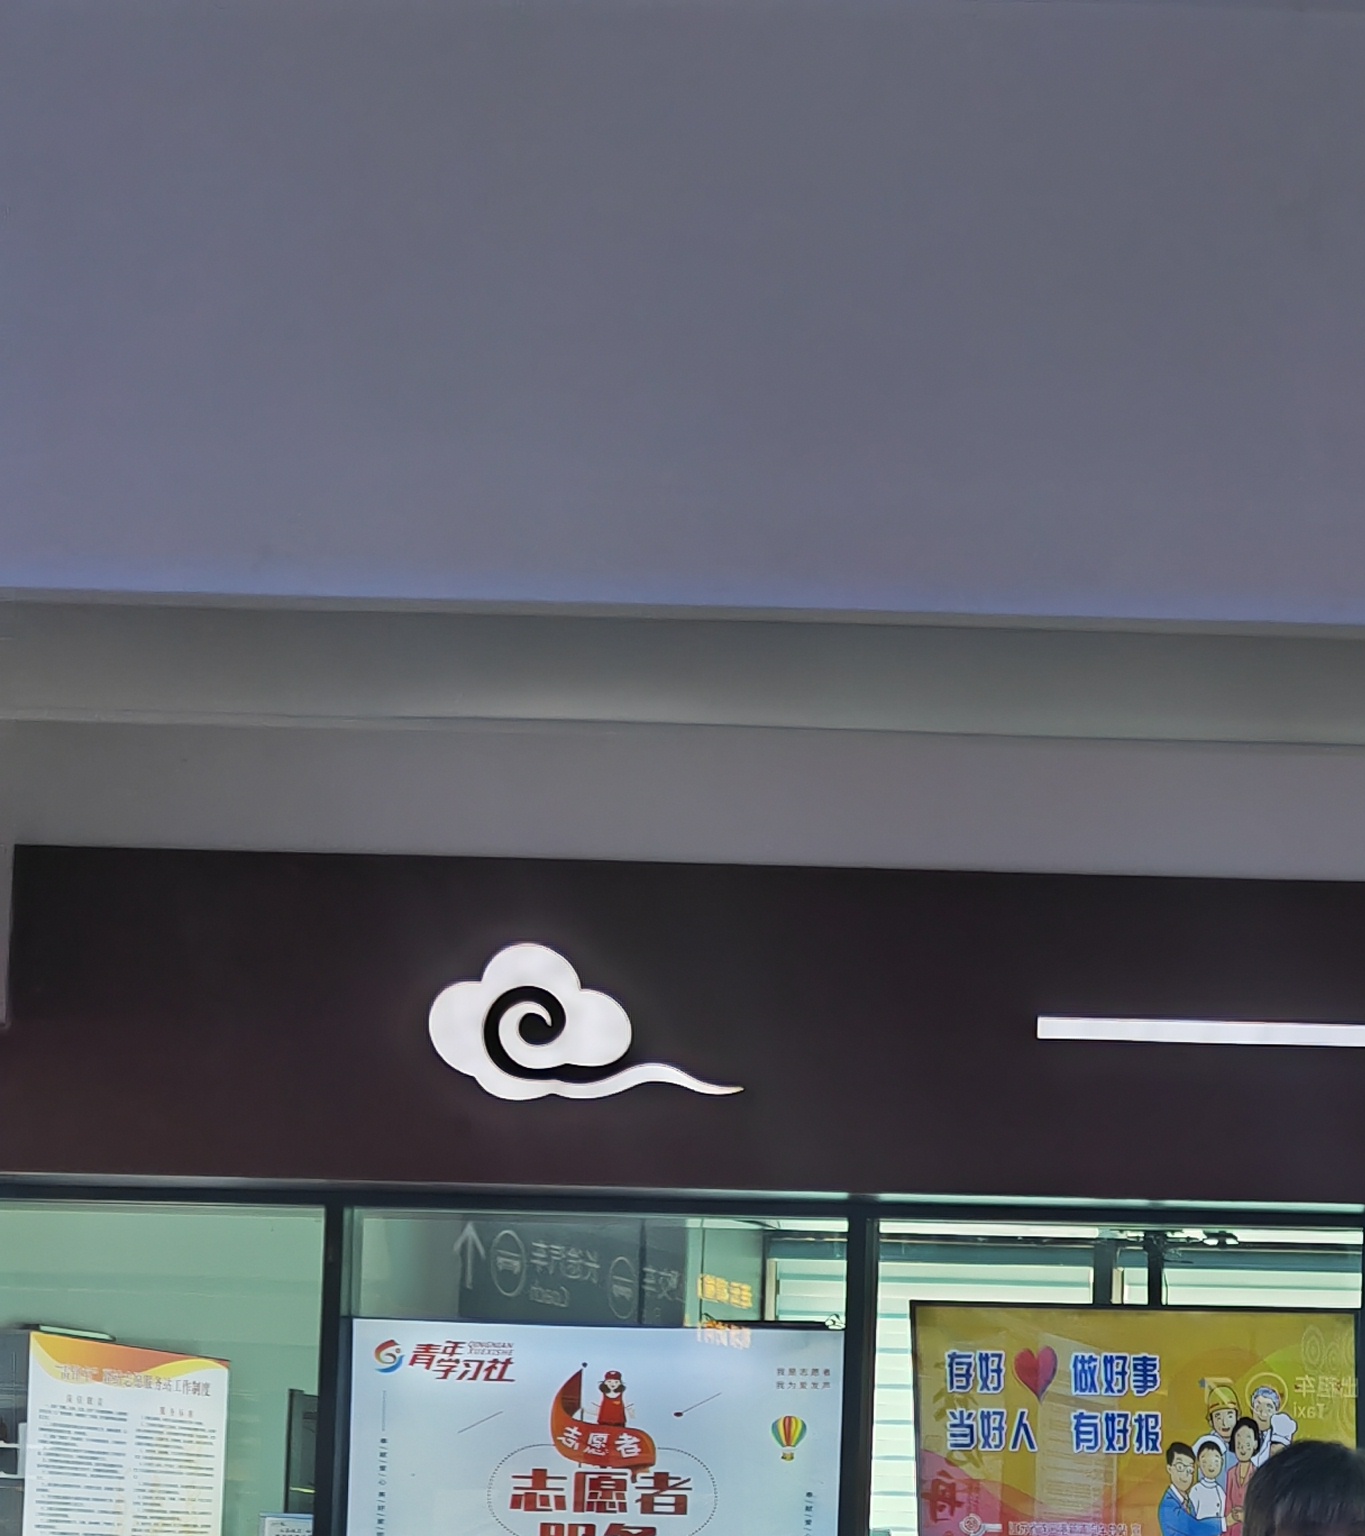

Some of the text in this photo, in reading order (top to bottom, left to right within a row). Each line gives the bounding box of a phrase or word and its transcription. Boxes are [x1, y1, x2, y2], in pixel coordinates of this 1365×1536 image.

[945, 1350, 1162, 1397] 存好 做好事
[557, 1425, 642, 1458] 志愿者
[945, 1409, 1163, 1455] 当好人 有好报
[509, 1468, 693, 1516] 志愿者
